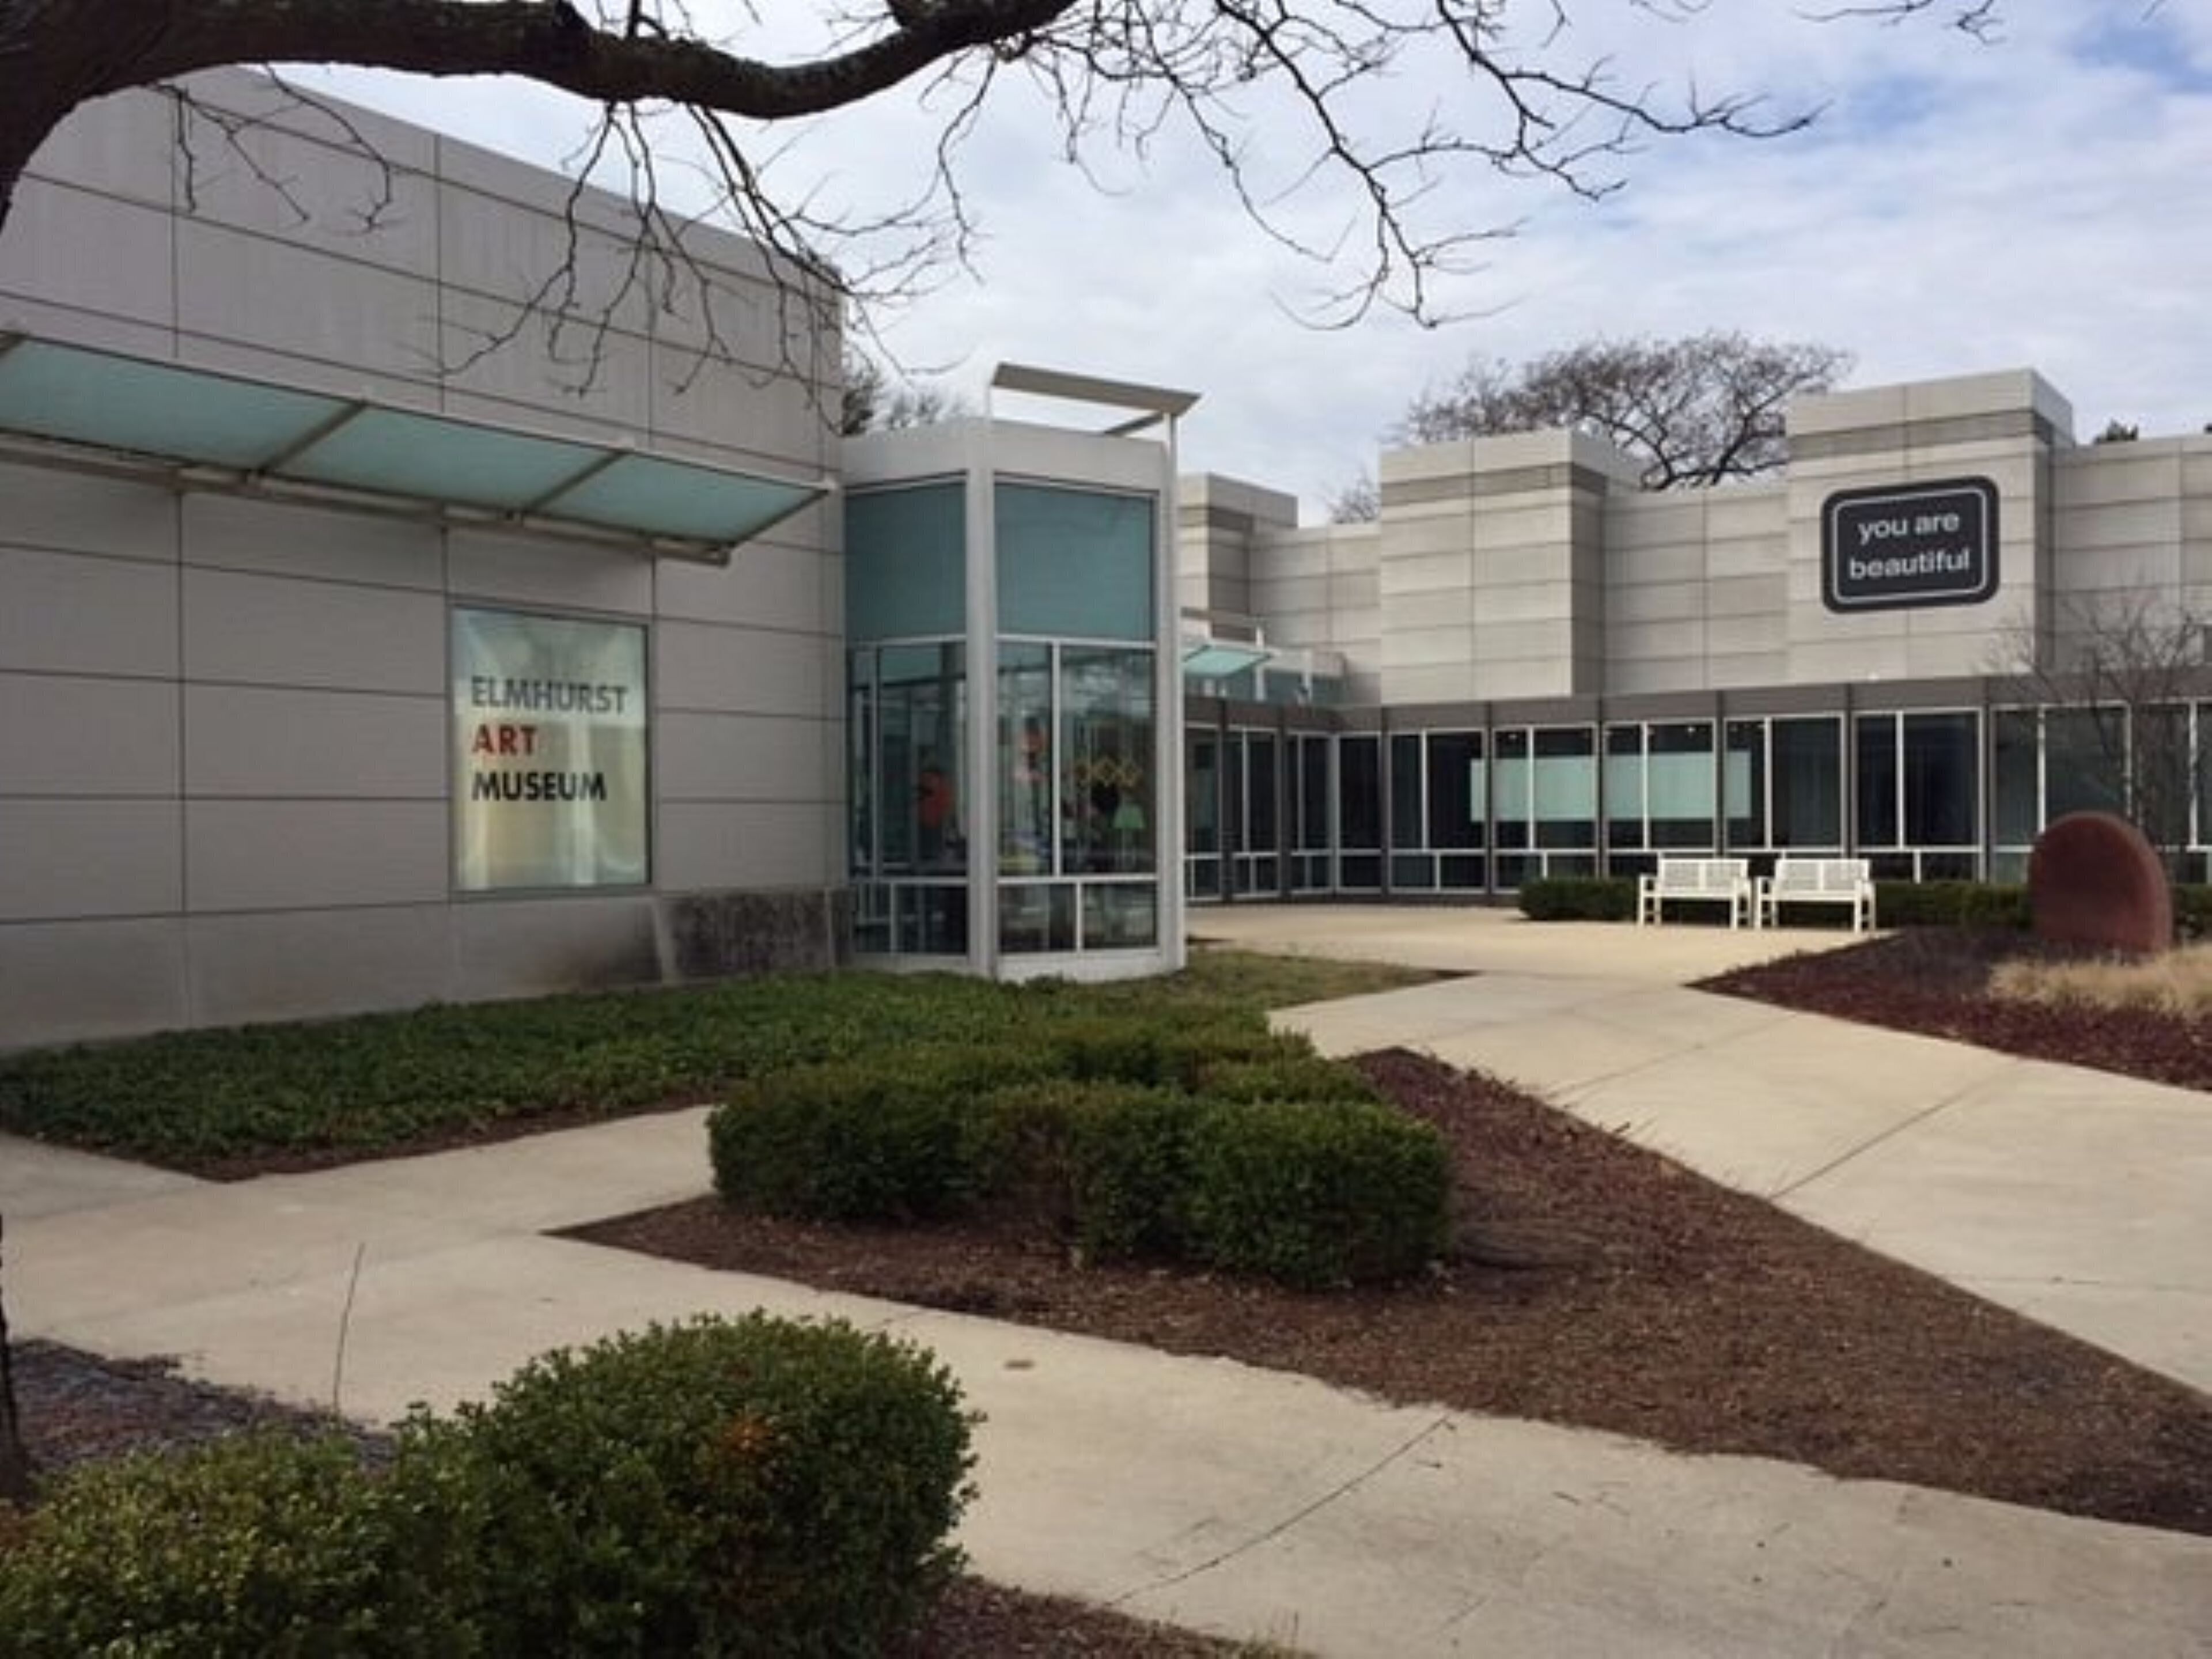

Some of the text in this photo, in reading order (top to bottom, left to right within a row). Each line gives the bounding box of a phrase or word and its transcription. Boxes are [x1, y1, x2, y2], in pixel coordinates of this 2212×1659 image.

[1858, 513, 1960, 546] you are
[1849, 548, 1970, 580] beautiful
[471, 675, 627, 715] ELMHURST
[472, 724, 537, 756] ART
[471, 771, 607, 801] MUSEUM
